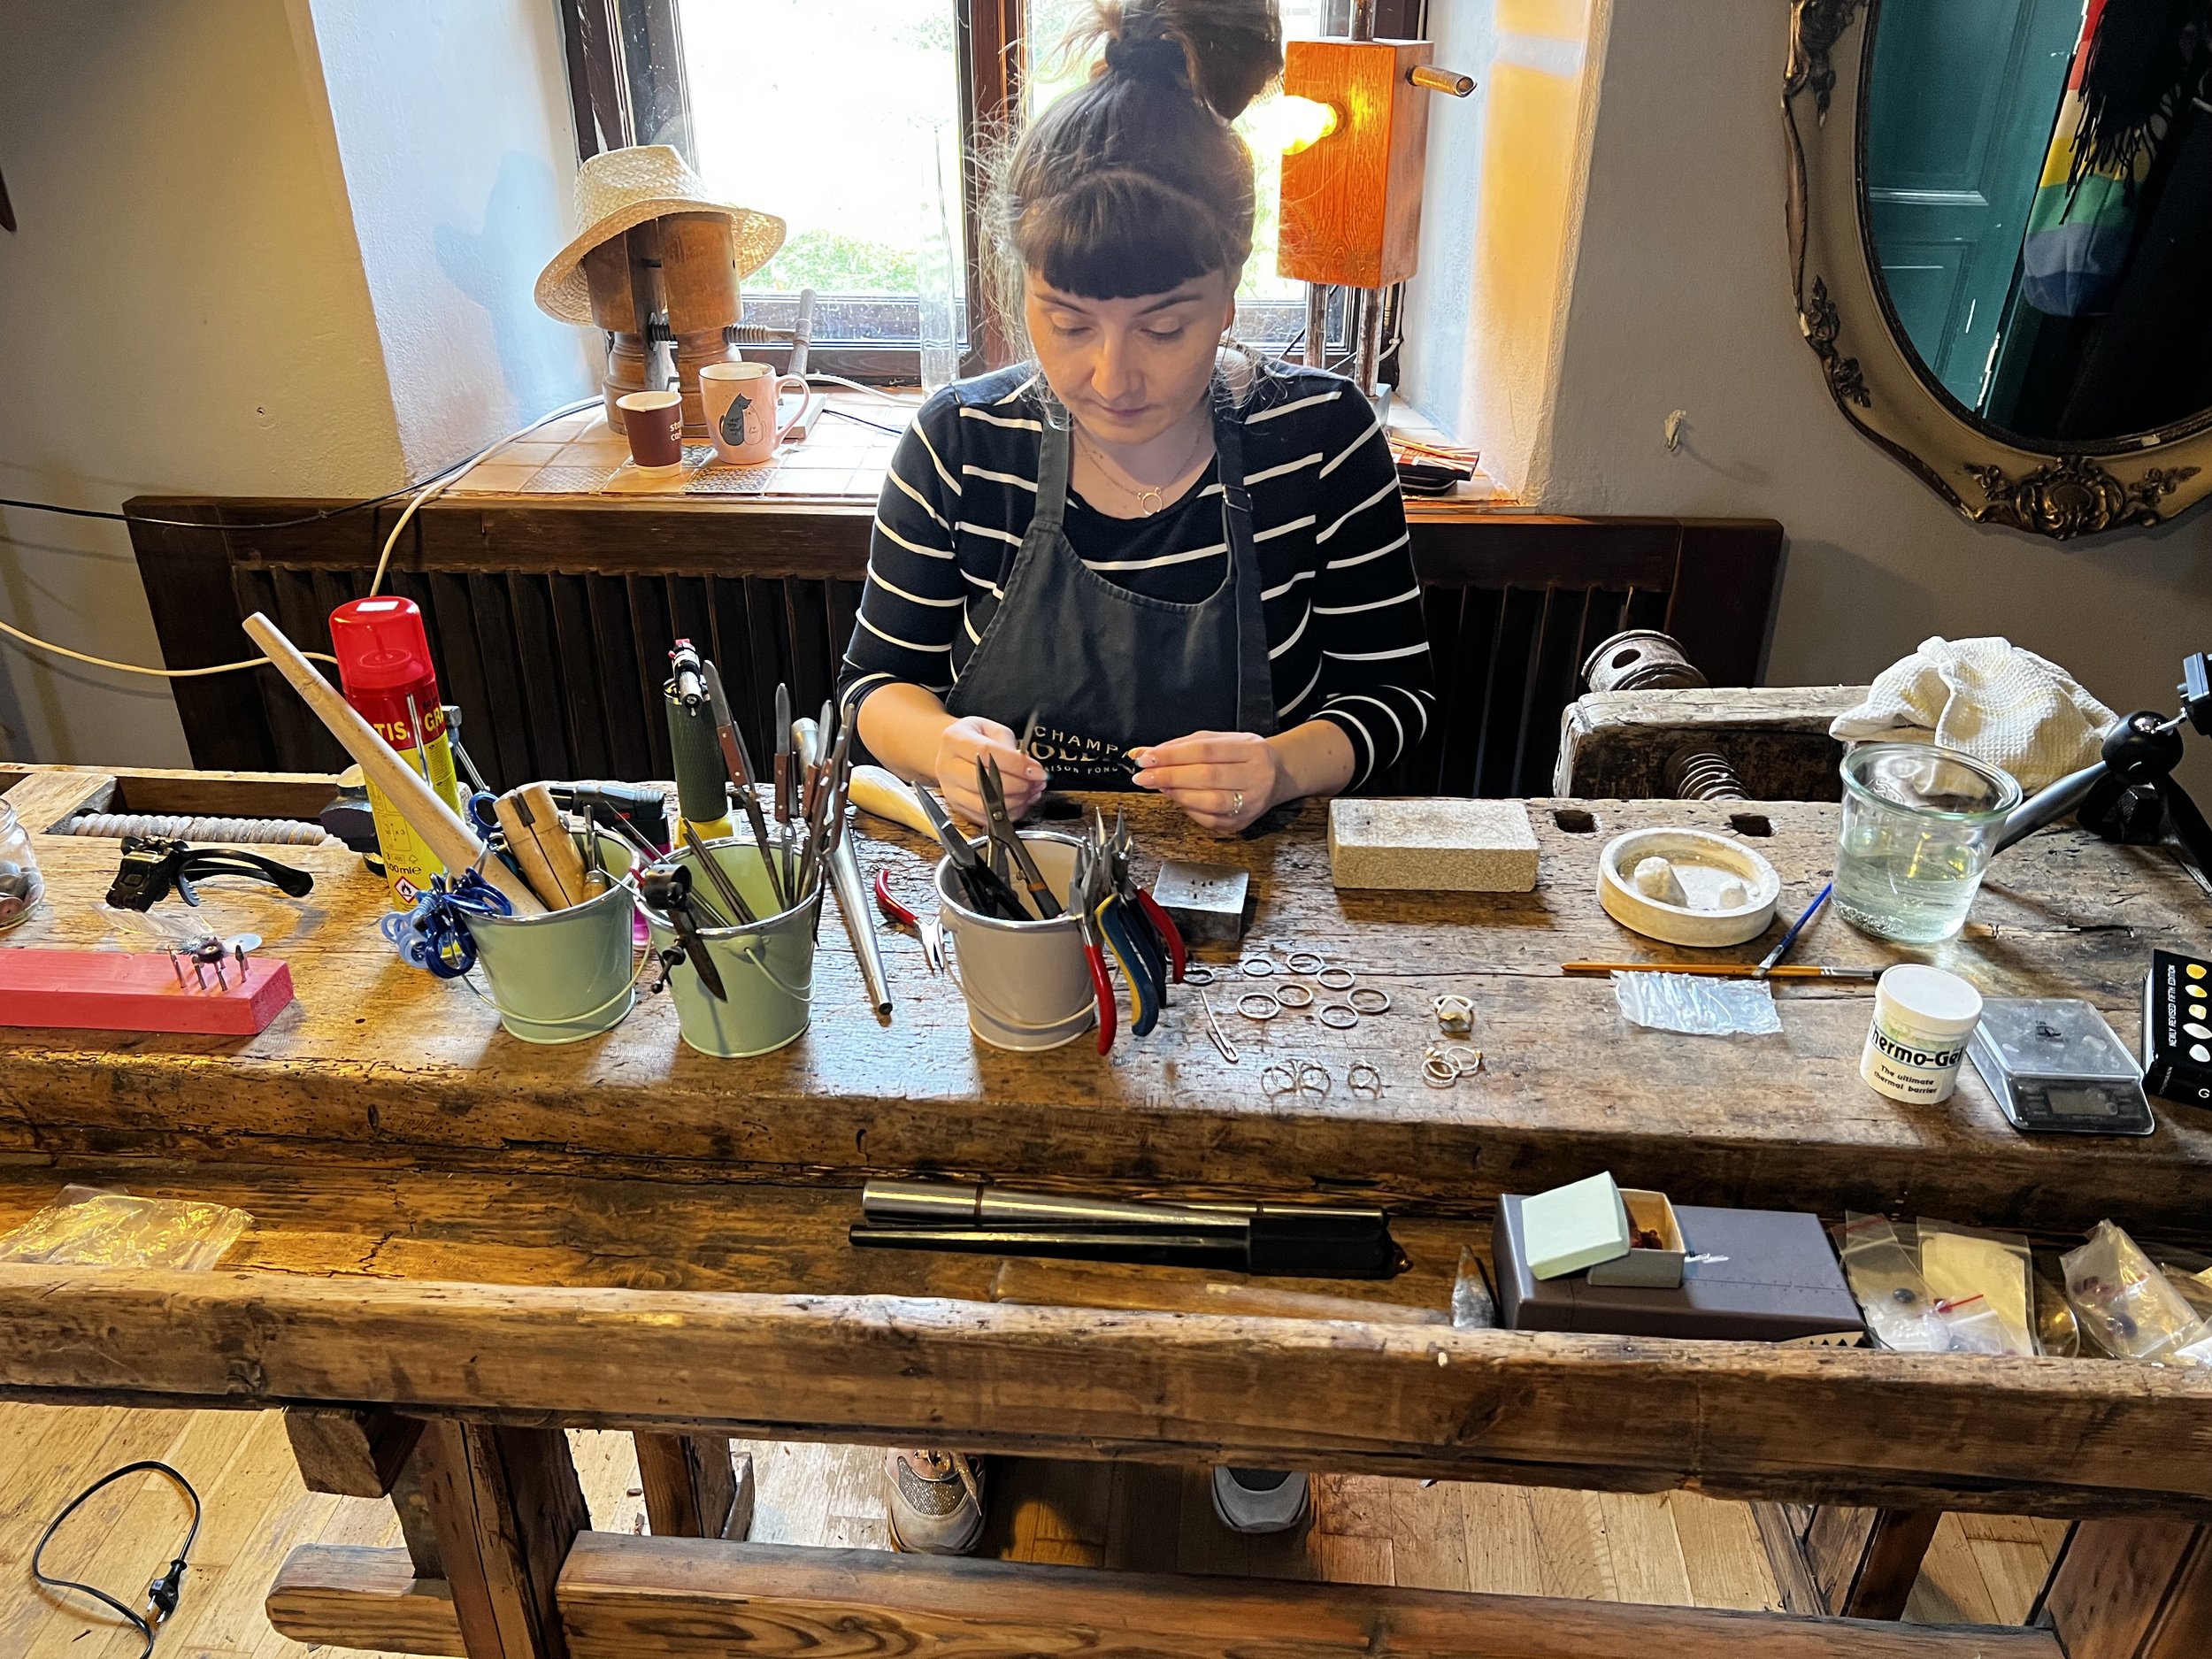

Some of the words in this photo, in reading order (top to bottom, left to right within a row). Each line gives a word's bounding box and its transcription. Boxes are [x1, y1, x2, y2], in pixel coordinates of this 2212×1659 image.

[2168, 964, 2177, 987] EDITION
[2168, 987, 2177, 1003] FIFTH
[2168, 1003, 2177, 1027] REVISED
[1873, 1071, 1904, 1090] thermal
[1908, 1085, 1939, 1094] barrier
[1880, 1064, 1895, 1077] The
[1897, 1072, 1934, 1086] ultimate
